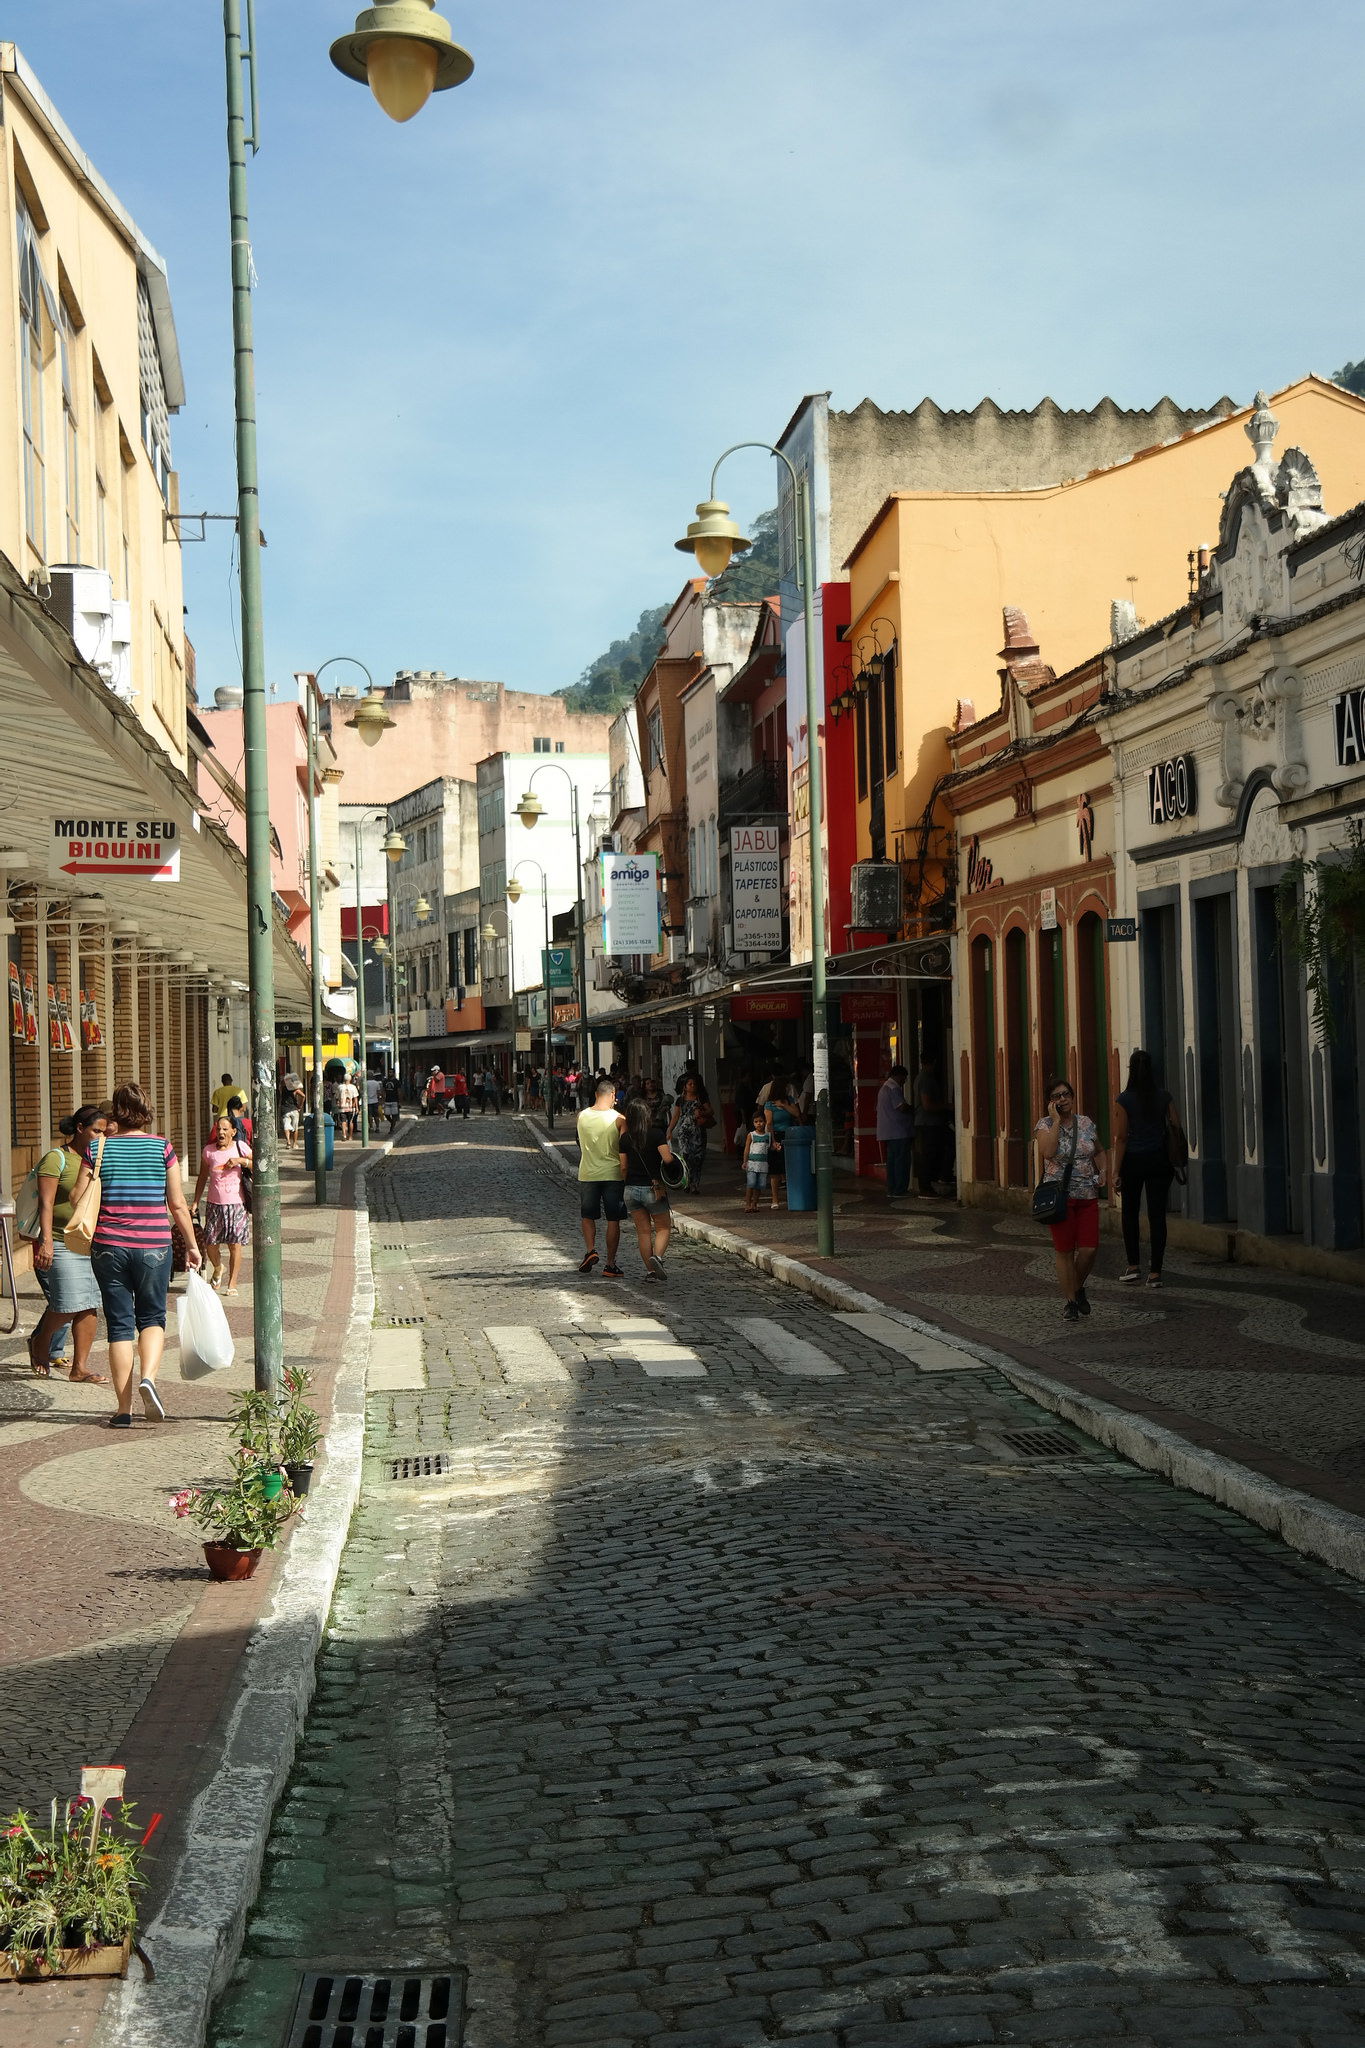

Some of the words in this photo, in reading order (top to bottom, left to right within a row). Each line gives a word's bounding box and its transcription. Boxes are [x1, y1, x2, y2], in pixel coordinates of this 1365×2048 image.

[1144, 756, 1189, 825] TACO
[55, 820, 128, 838] MONTE
[136, 821, 176, 839] SEU
[734, 830, 777, 851] JABU
[68, 840, 161, 860] BIQUÍNI
[734, 860, 778, 872] PLÁSTICOS
[610, 869, 650, 882] amiga
[735, 878, 778, 890] TAPETES
[754, 894, 760, 903] &
[735, 908, 780, 919] CAPOTARIA
[1110, 924, 1134, 936] TACO
[750, 1002, 787, 1011] POPULAR
